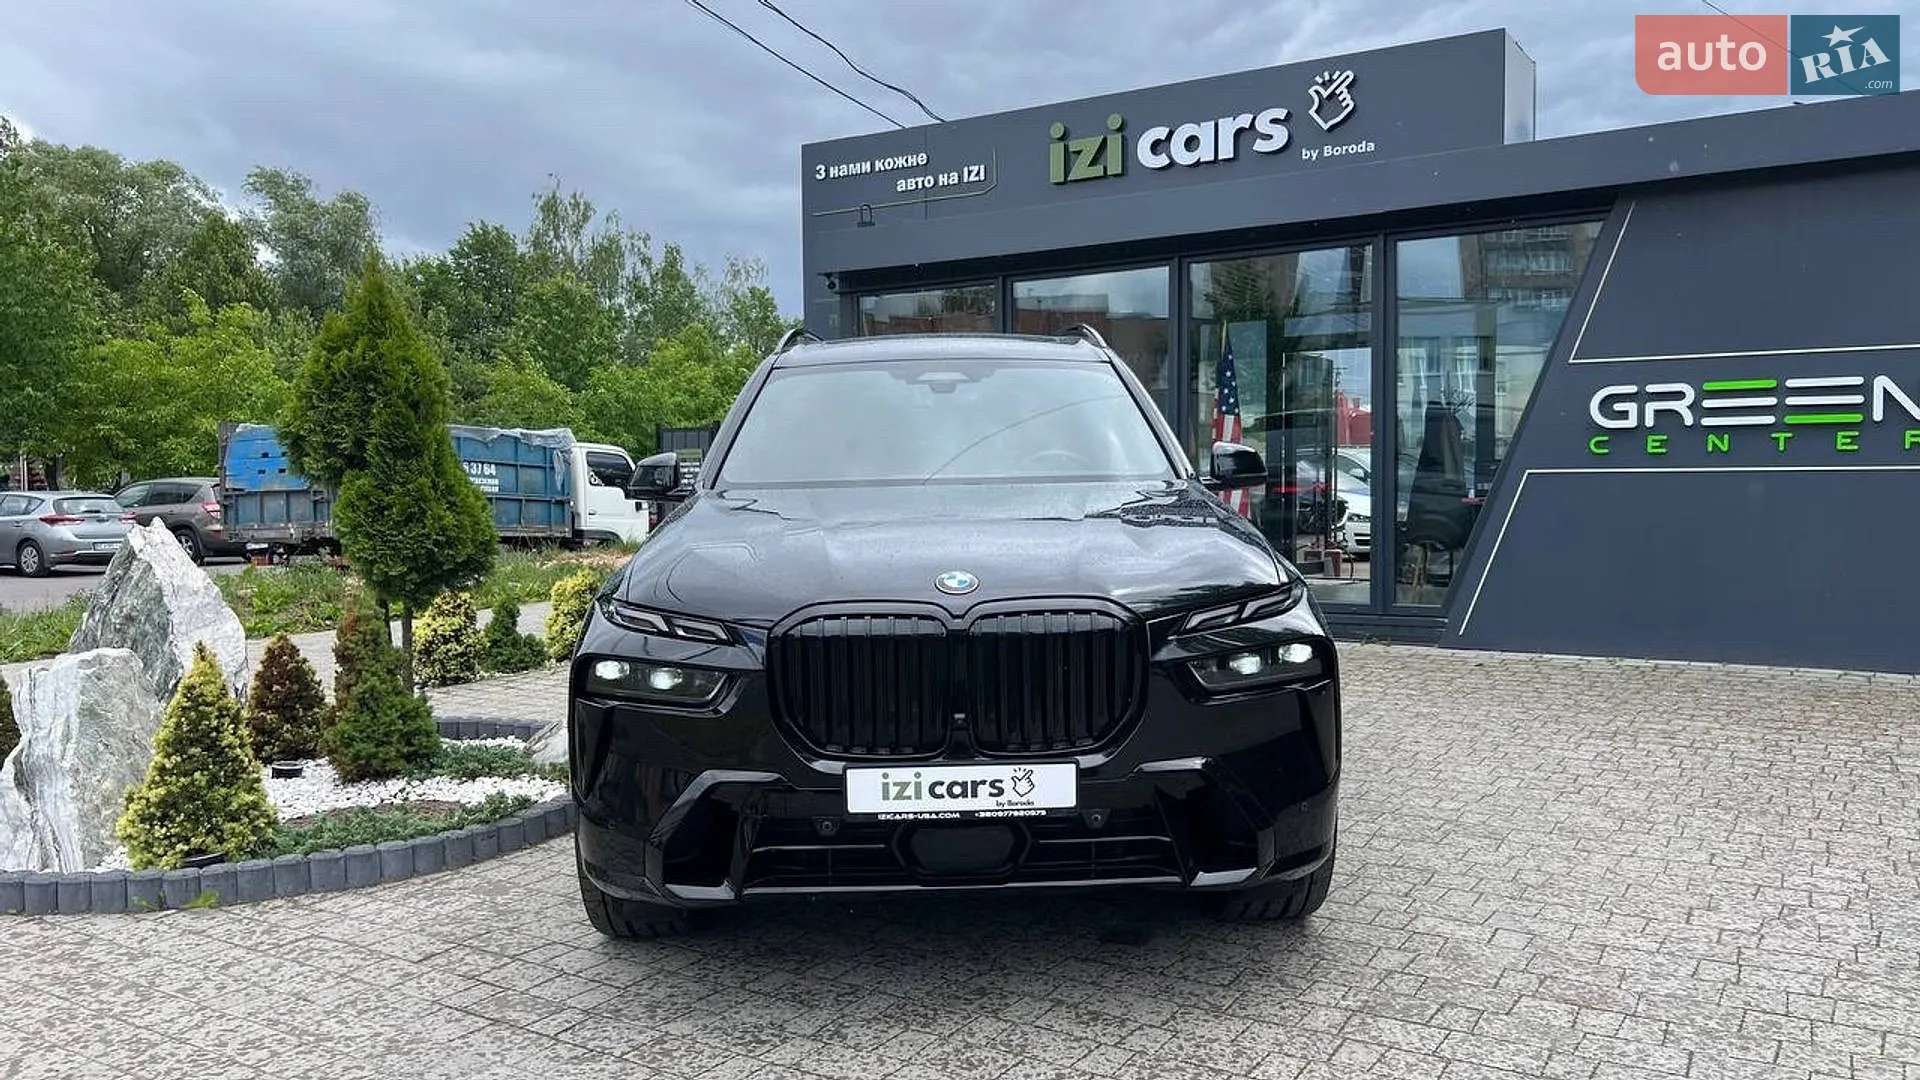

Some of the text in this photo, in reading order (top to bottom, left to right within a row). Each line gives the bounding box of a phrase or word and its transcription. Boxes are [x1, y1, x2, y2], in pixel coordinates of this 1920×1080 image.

[1050, 107, 1290, 184] izi cars
[1301, 140, 1375, 161] by Boroda
[829, 160, 872, 179] нами
[875, 152, 929, 172] кожне
[896, 164, 986, 192] авто на IZI
[881, 771, 1005, 801] izi cars
